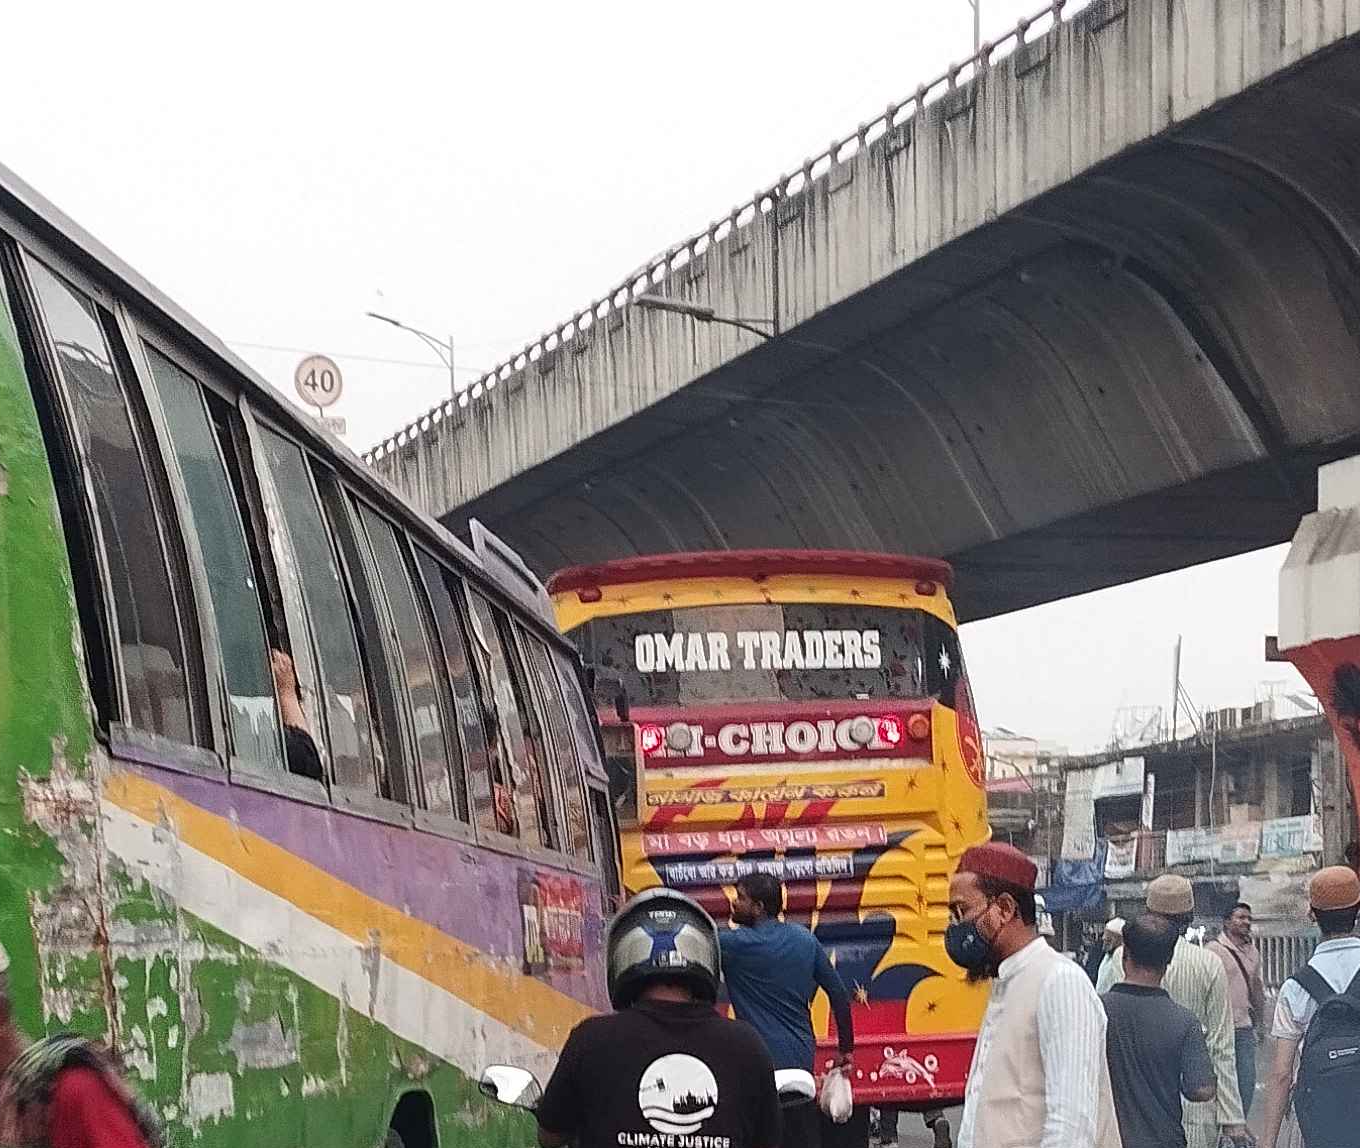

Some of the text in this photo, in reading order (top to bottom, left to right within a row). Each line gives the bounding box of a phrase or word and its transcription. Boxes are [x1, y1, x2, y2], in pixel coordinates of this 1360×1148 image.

[303, 368, 335, 393] 40
[635, 629, 883, 674] OMAR TRADERS
[617, 1131, 675, 1147] CLIMATE
